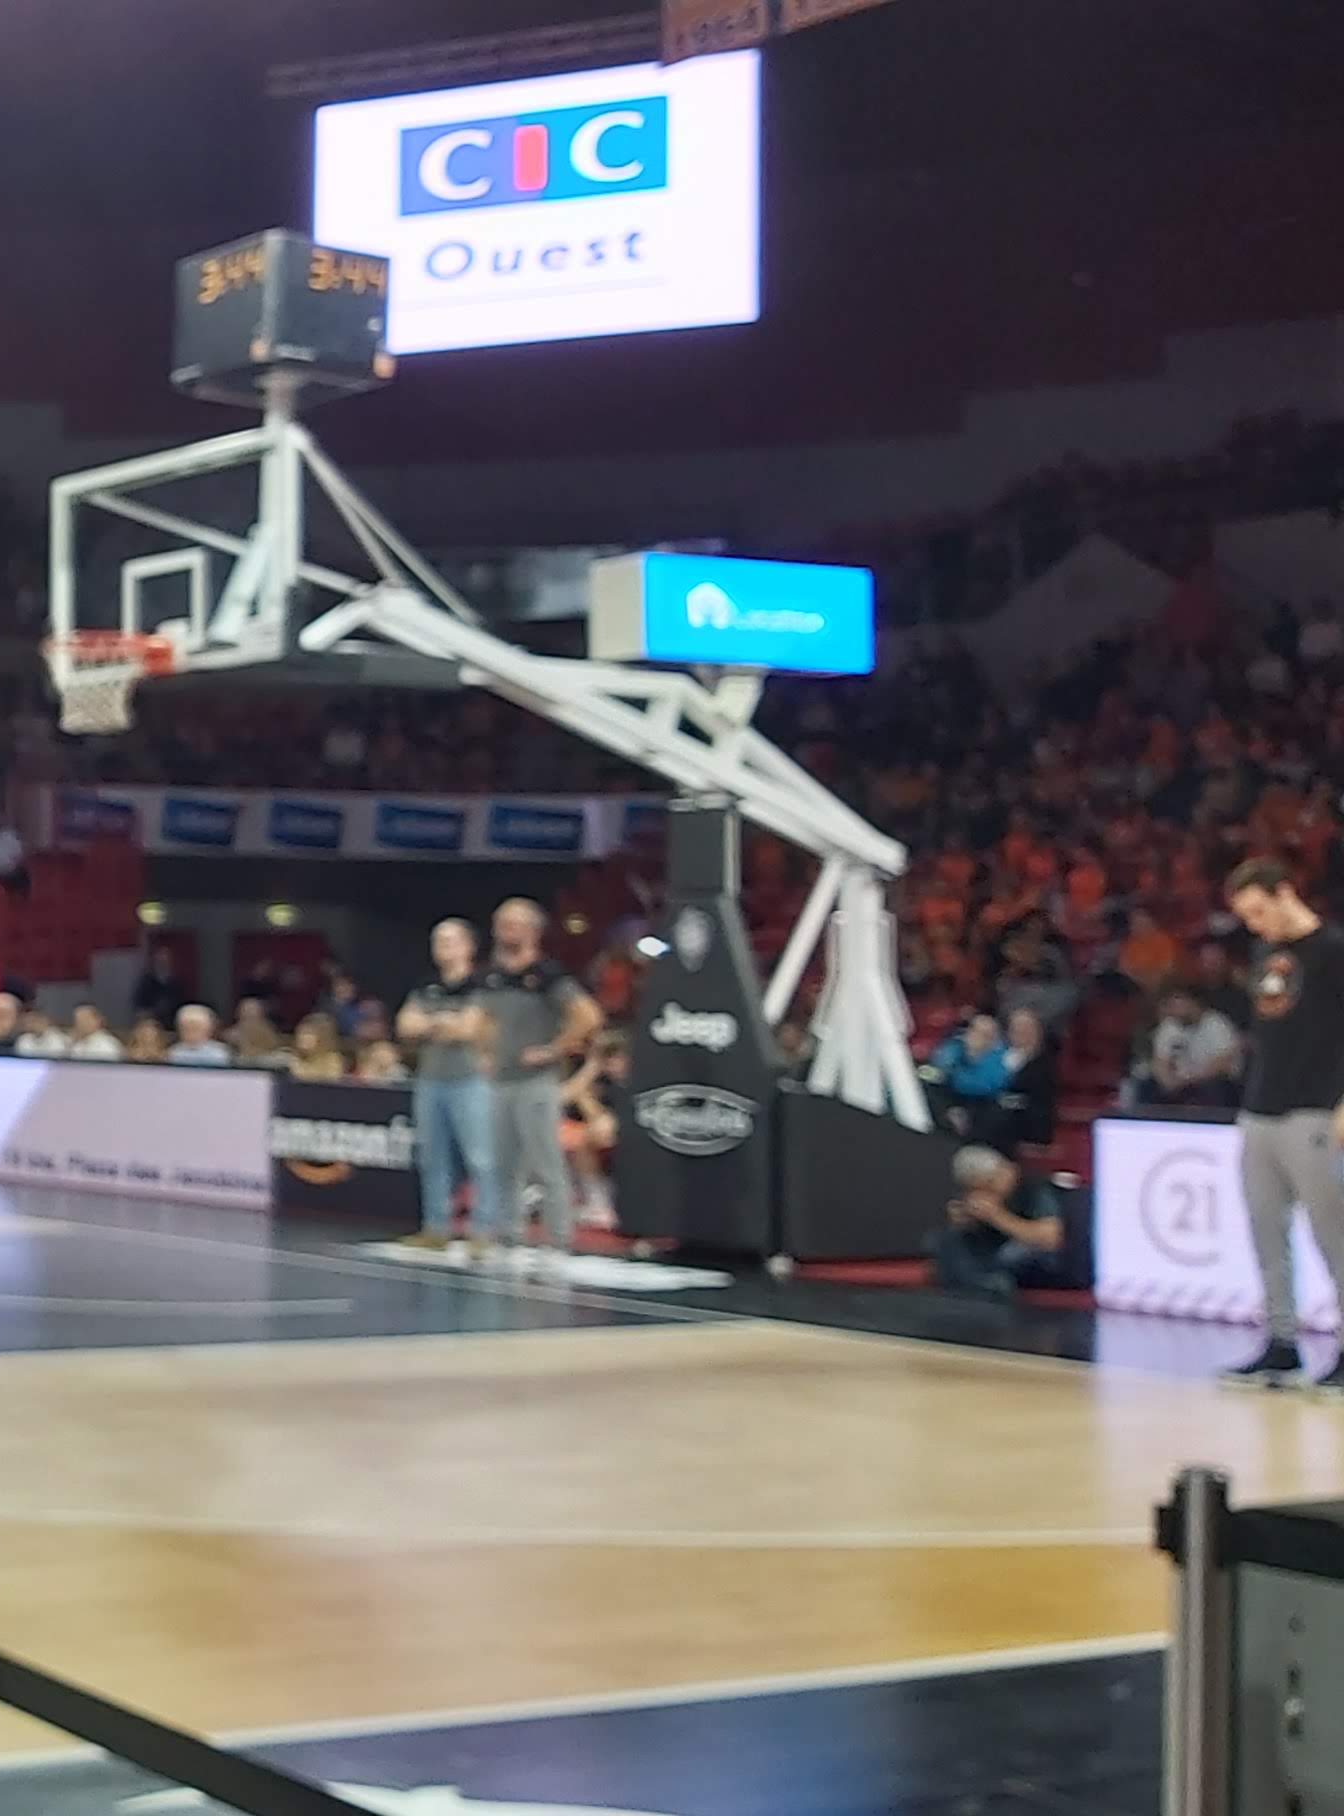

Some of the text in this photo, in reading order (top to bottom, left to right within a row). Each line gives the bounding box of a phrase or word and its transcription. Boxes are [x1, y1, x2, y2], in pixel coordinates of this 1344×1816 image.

[419, 109, 646, 201] CIC
[425, 230, 646, 280] Ouest
[649, 1000, 739, 1054] Jeep
[1168, 1182, 1219, 1233] 21
